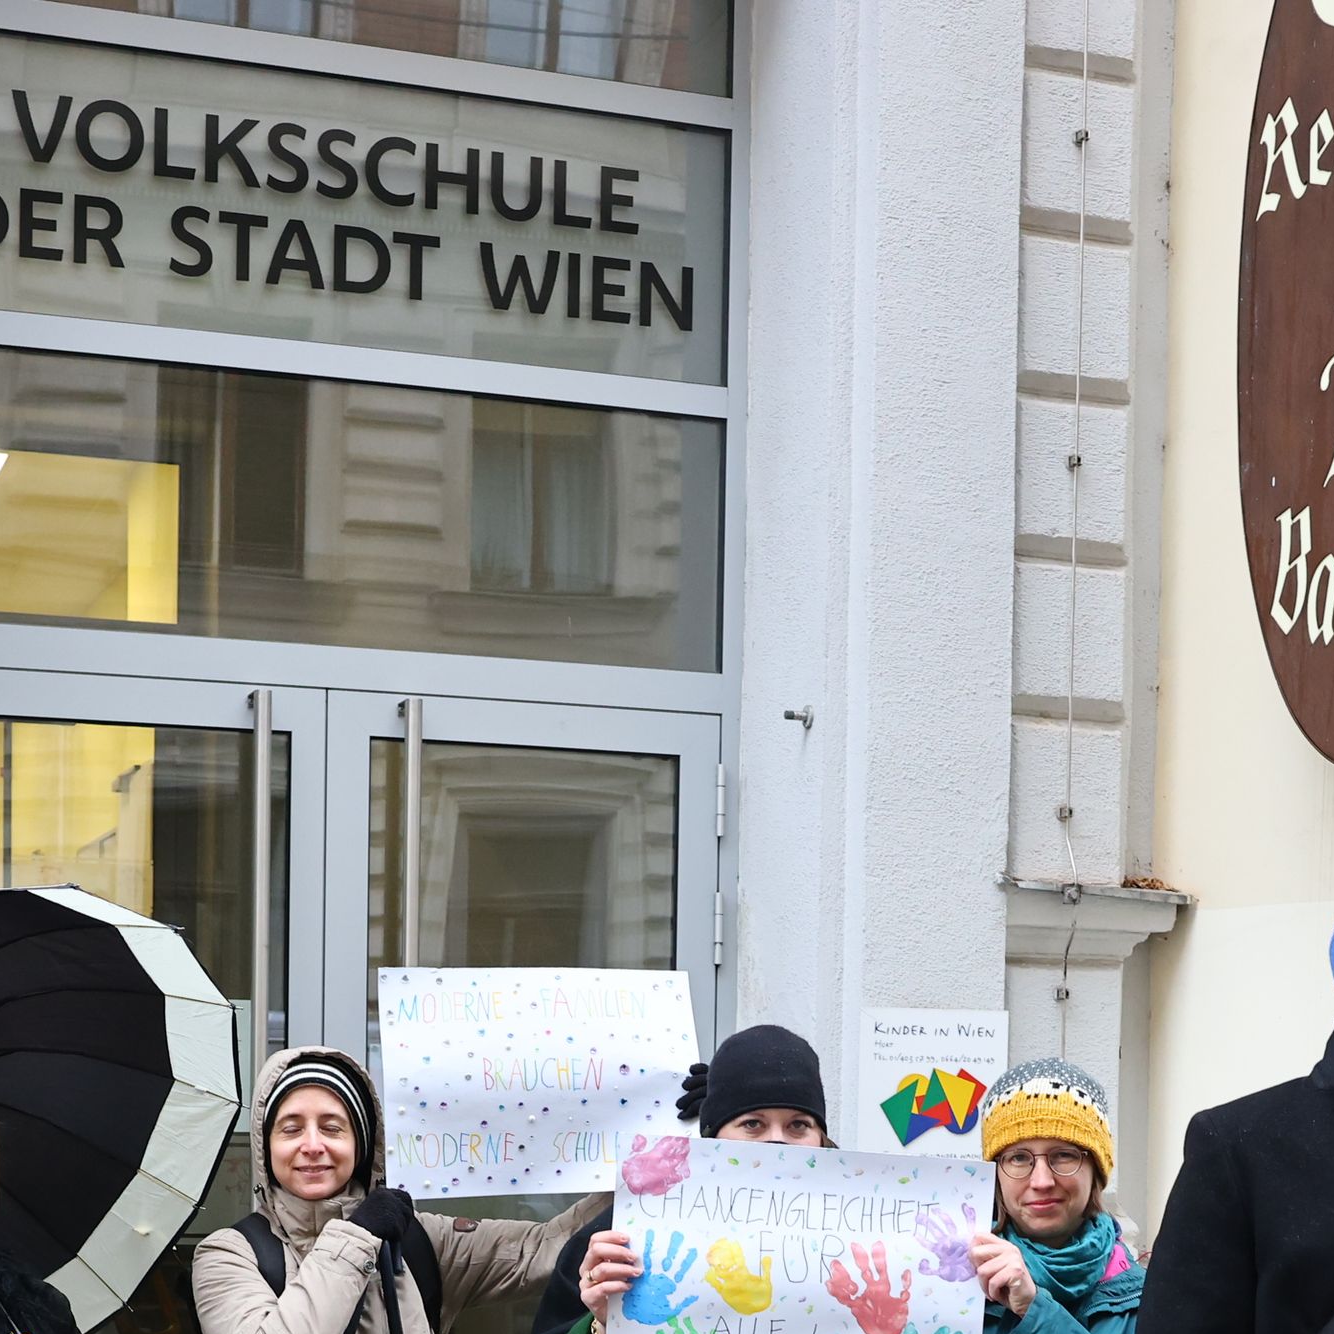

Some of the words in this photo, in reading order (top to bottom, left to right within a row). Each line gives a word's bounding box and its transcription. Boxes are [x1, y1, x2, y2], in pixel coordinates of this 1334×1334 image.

[12, 89, 639, 235] VOLKSSCHULE
[169, 205, 441, 300] STADT
[481, 242, 694, 332] WIEN
[398, 991, 503, 1023] MODERNE
[540, 987, 645, 1019] FAMILIEN
[874, 1021, 927, 1036] KINDER
[934, 1027, 949, 1037] IN
[957, 1023, 995, 1038] WIEN
[483, 1057, 603, 1091] BRAUCHEN
[397, 1132, 516, 1168] MODERNE
[549, 1131, 618, 1164] SCHUL
[639, 1186, 940, 1238] CHANCENGLEICHHEIT
[757, 1230, 845, 1284] FÜR
